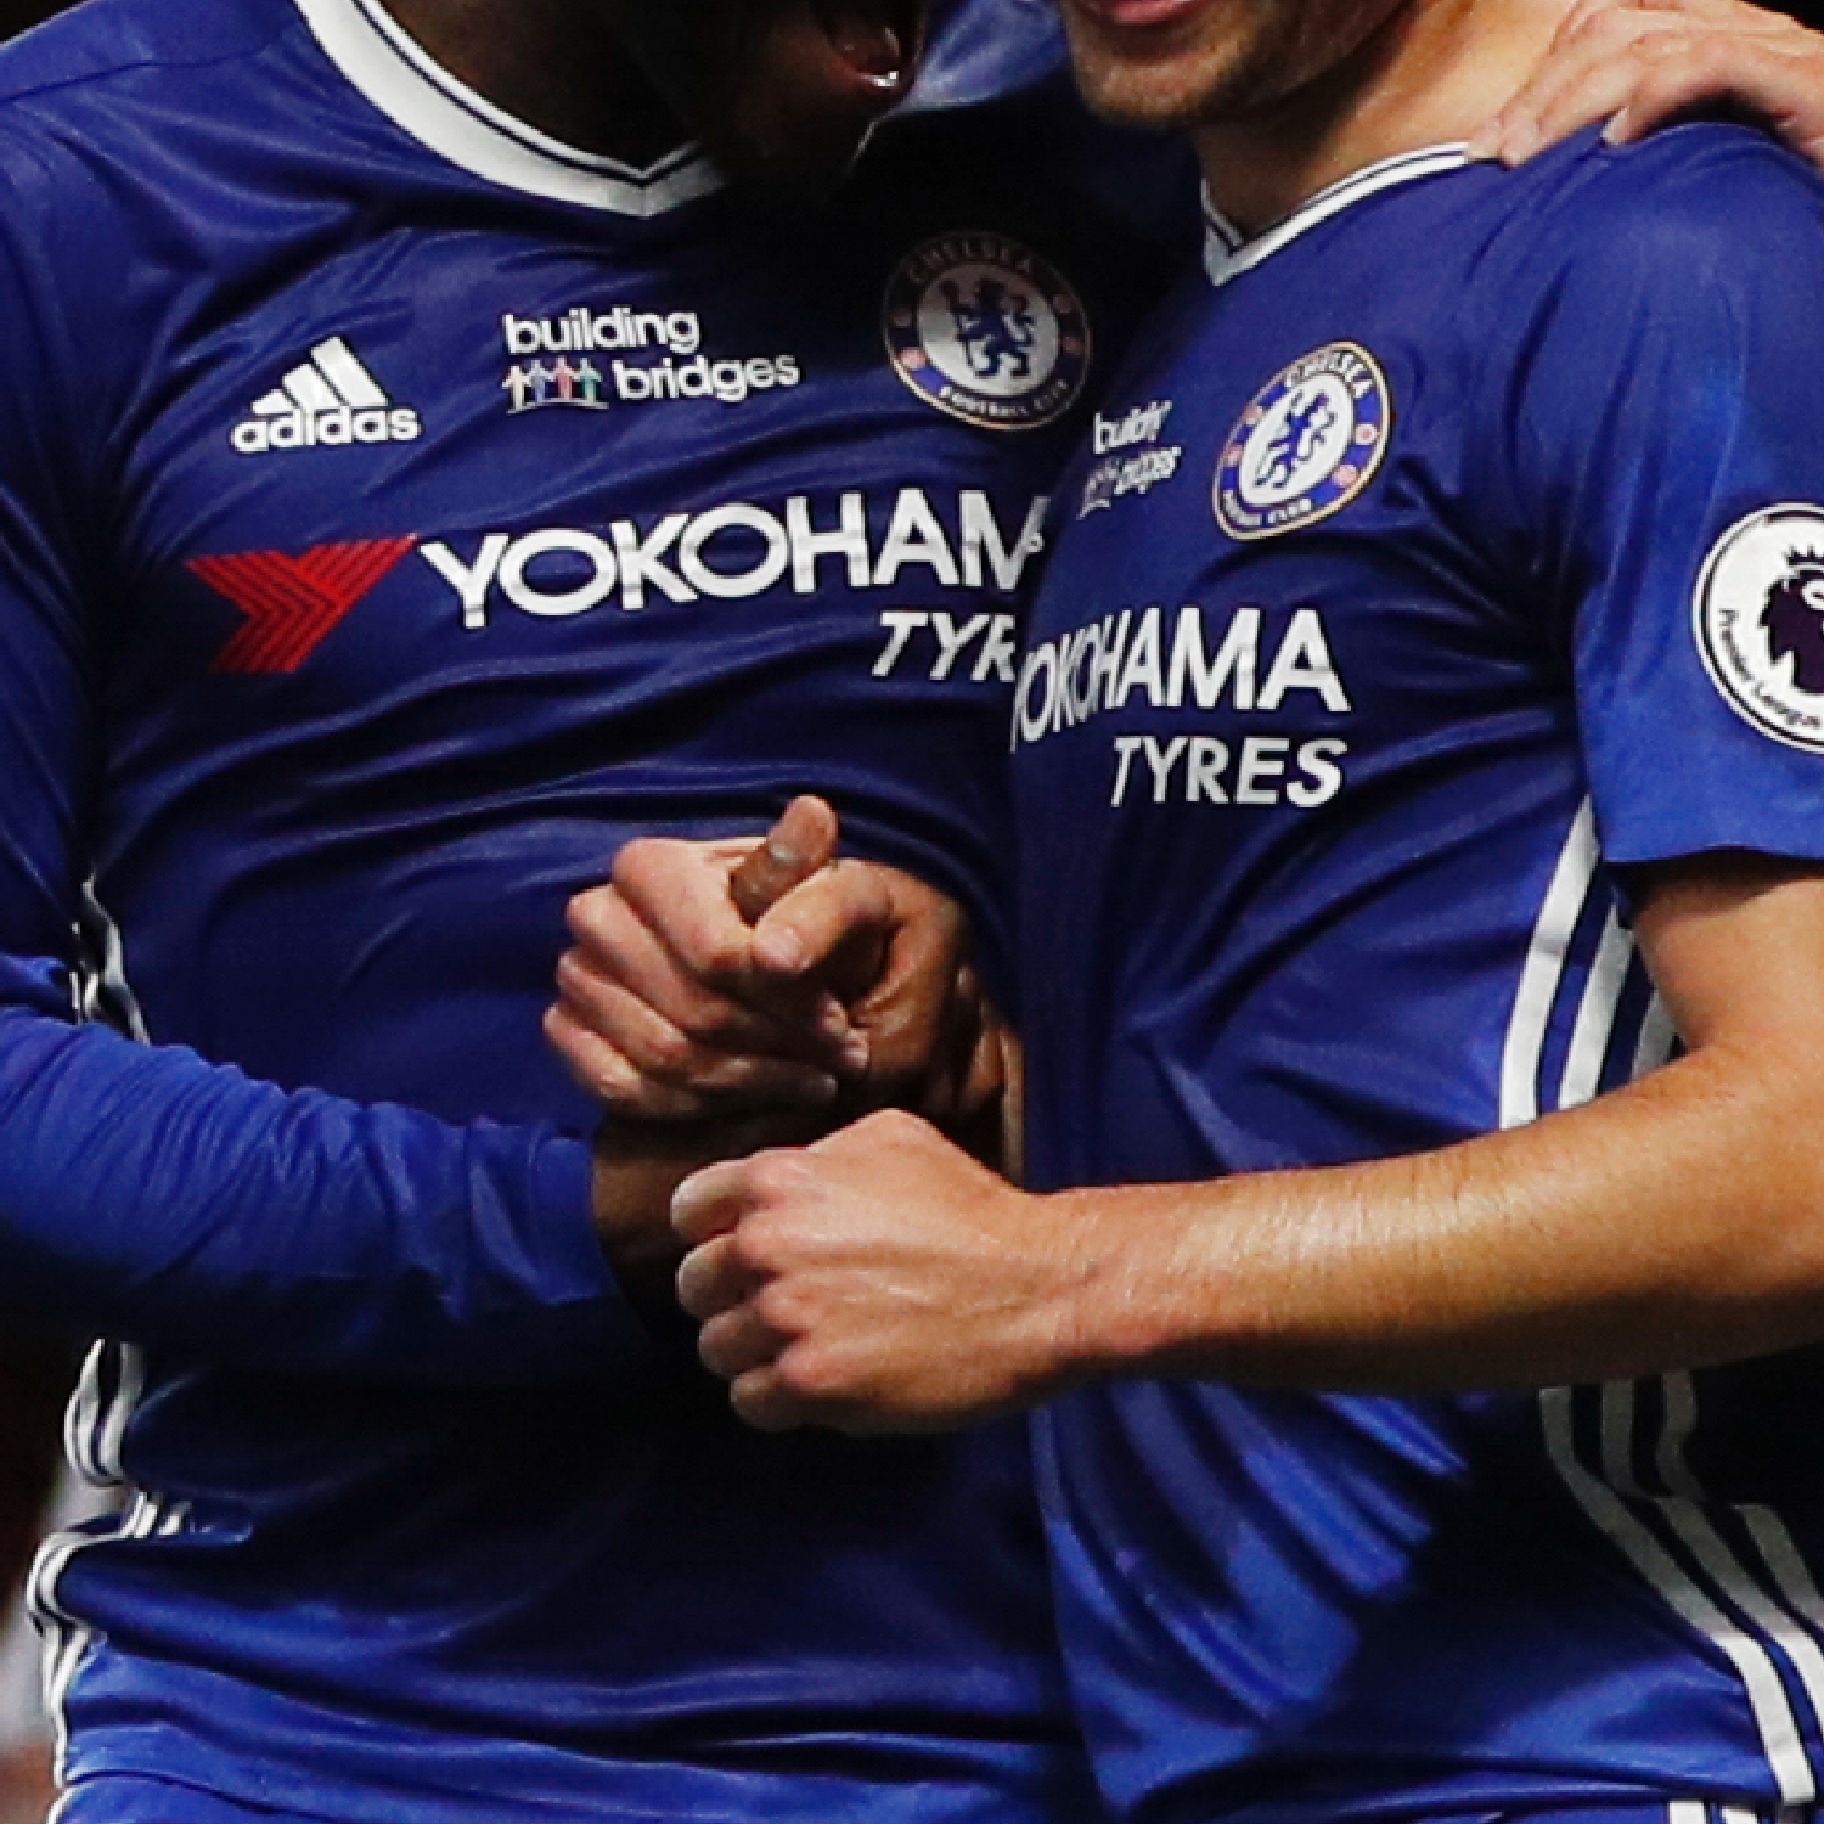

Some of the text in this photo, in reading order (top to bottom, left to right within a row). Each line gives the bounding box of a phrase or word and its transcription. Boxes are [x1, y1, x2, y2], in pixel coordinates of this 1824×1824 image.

[504, 307, 701, 355] building
[612, 354, 801, 402] bridges
[231, 404, 422, 454] adidas
[420, 487, 1051, 628] YOKOHAM
[871, 610, 1016, 682] TYR
[1009, 607, 1352, 754] OKOHAMA
[1111, 736, 1349, 808] TYRES
